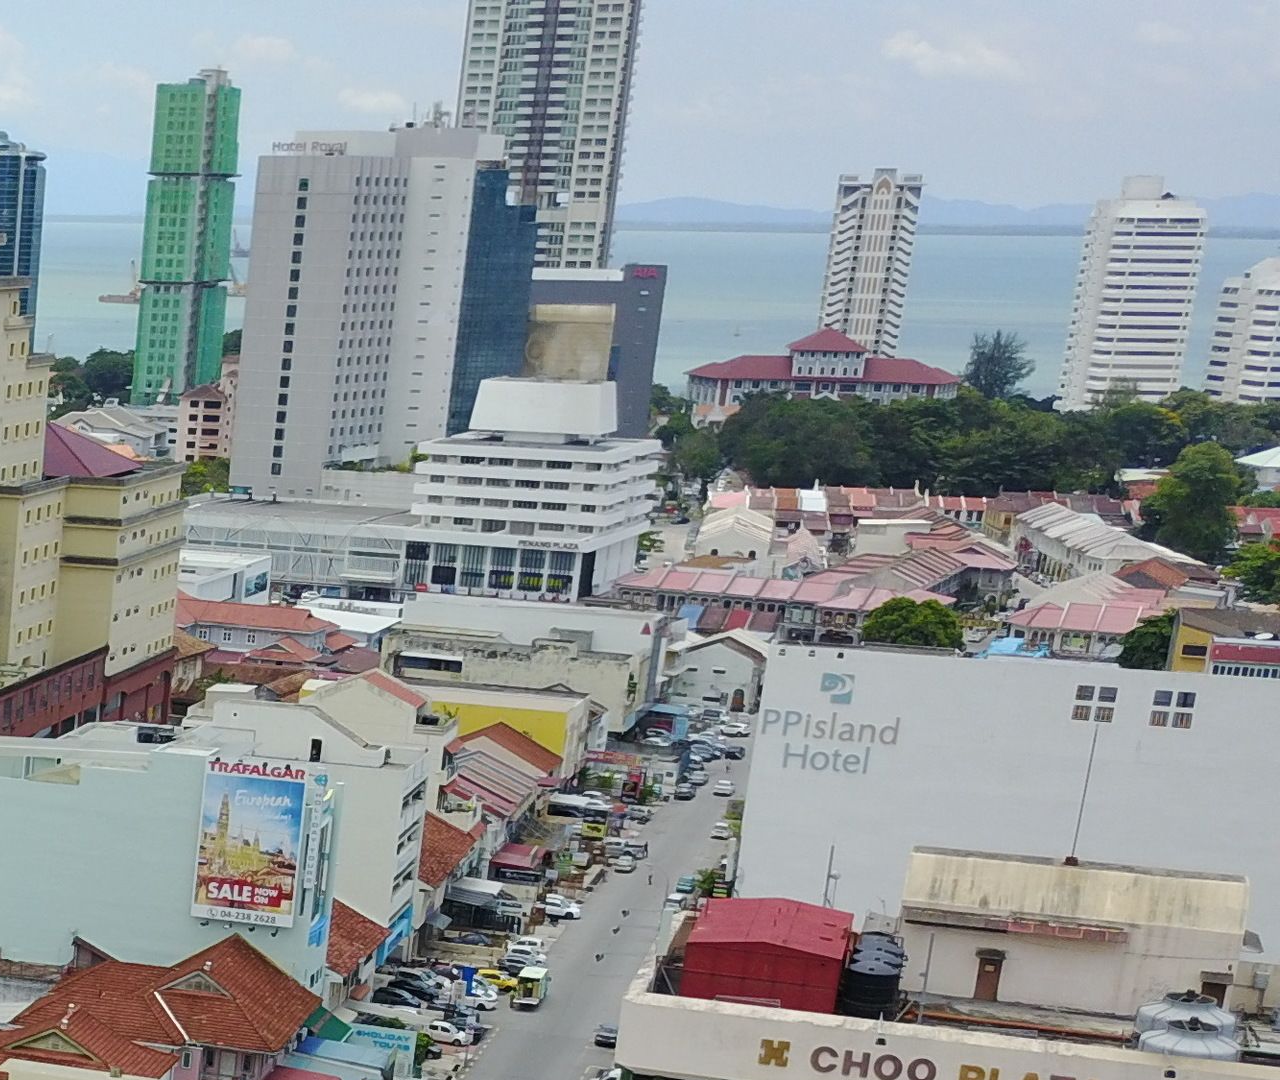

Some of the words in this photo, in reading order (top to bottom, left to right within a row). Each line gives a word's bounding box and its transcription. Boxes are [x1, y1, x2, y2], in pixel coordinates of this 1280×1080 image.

[272, 142, 306, 152] Hotel
[311, 142, 347, 153] Royal
[518, 540, 552, 549] PENANG
[553, 542, 579, 550] PLAZA
[761, 709, 901, 745] PPisland
[782, 743, 871, 775] Hotel
[209, 761, 305, 780] TRAFALGAR
[234, 789, 293, 809] European
[310, 791, 322, 843] HOLIDAY
[207, 881, 252, 902] SALE
[253, 896, 269, 905] ON
[254, 887, 279, 898] NOW
[362, 1029, 411, 1042] HOLIDAY
